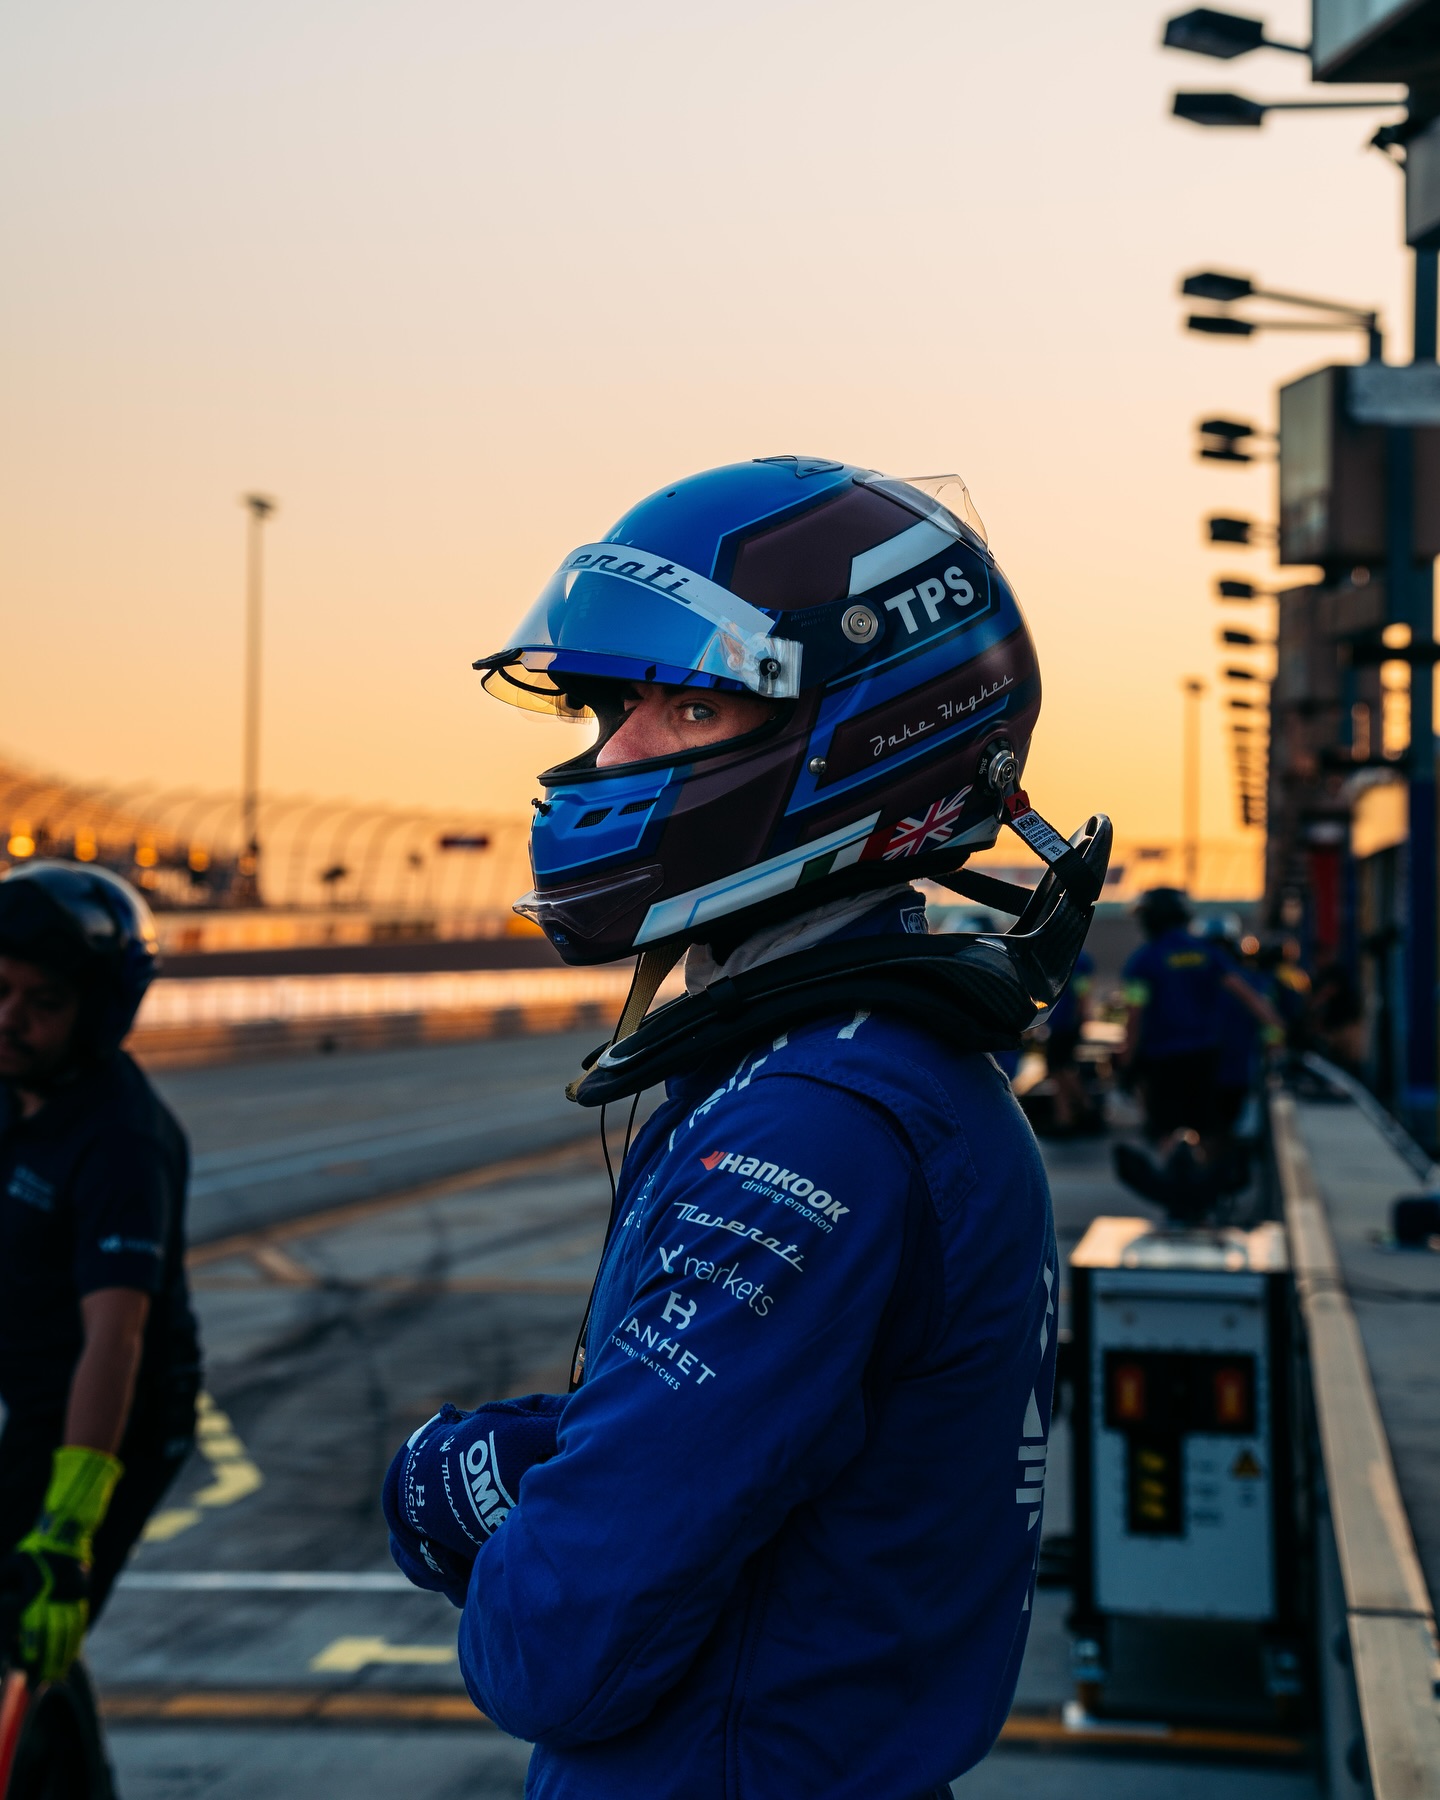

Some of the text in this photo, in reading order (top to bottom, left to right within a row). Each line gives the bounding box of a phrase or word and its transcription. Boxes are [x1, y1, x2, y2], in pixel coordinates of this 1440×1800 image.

[563, 554, 692, 605] erati
[884, 566, 974, 635] TPS
[870, 675, 1013, 756] Jake Hughes
[674, 1202, 803, 1272] Maserati
[741, 1179, 833, 1234] driving emotion
[640, 1353, 681, 1390] WATCHES
